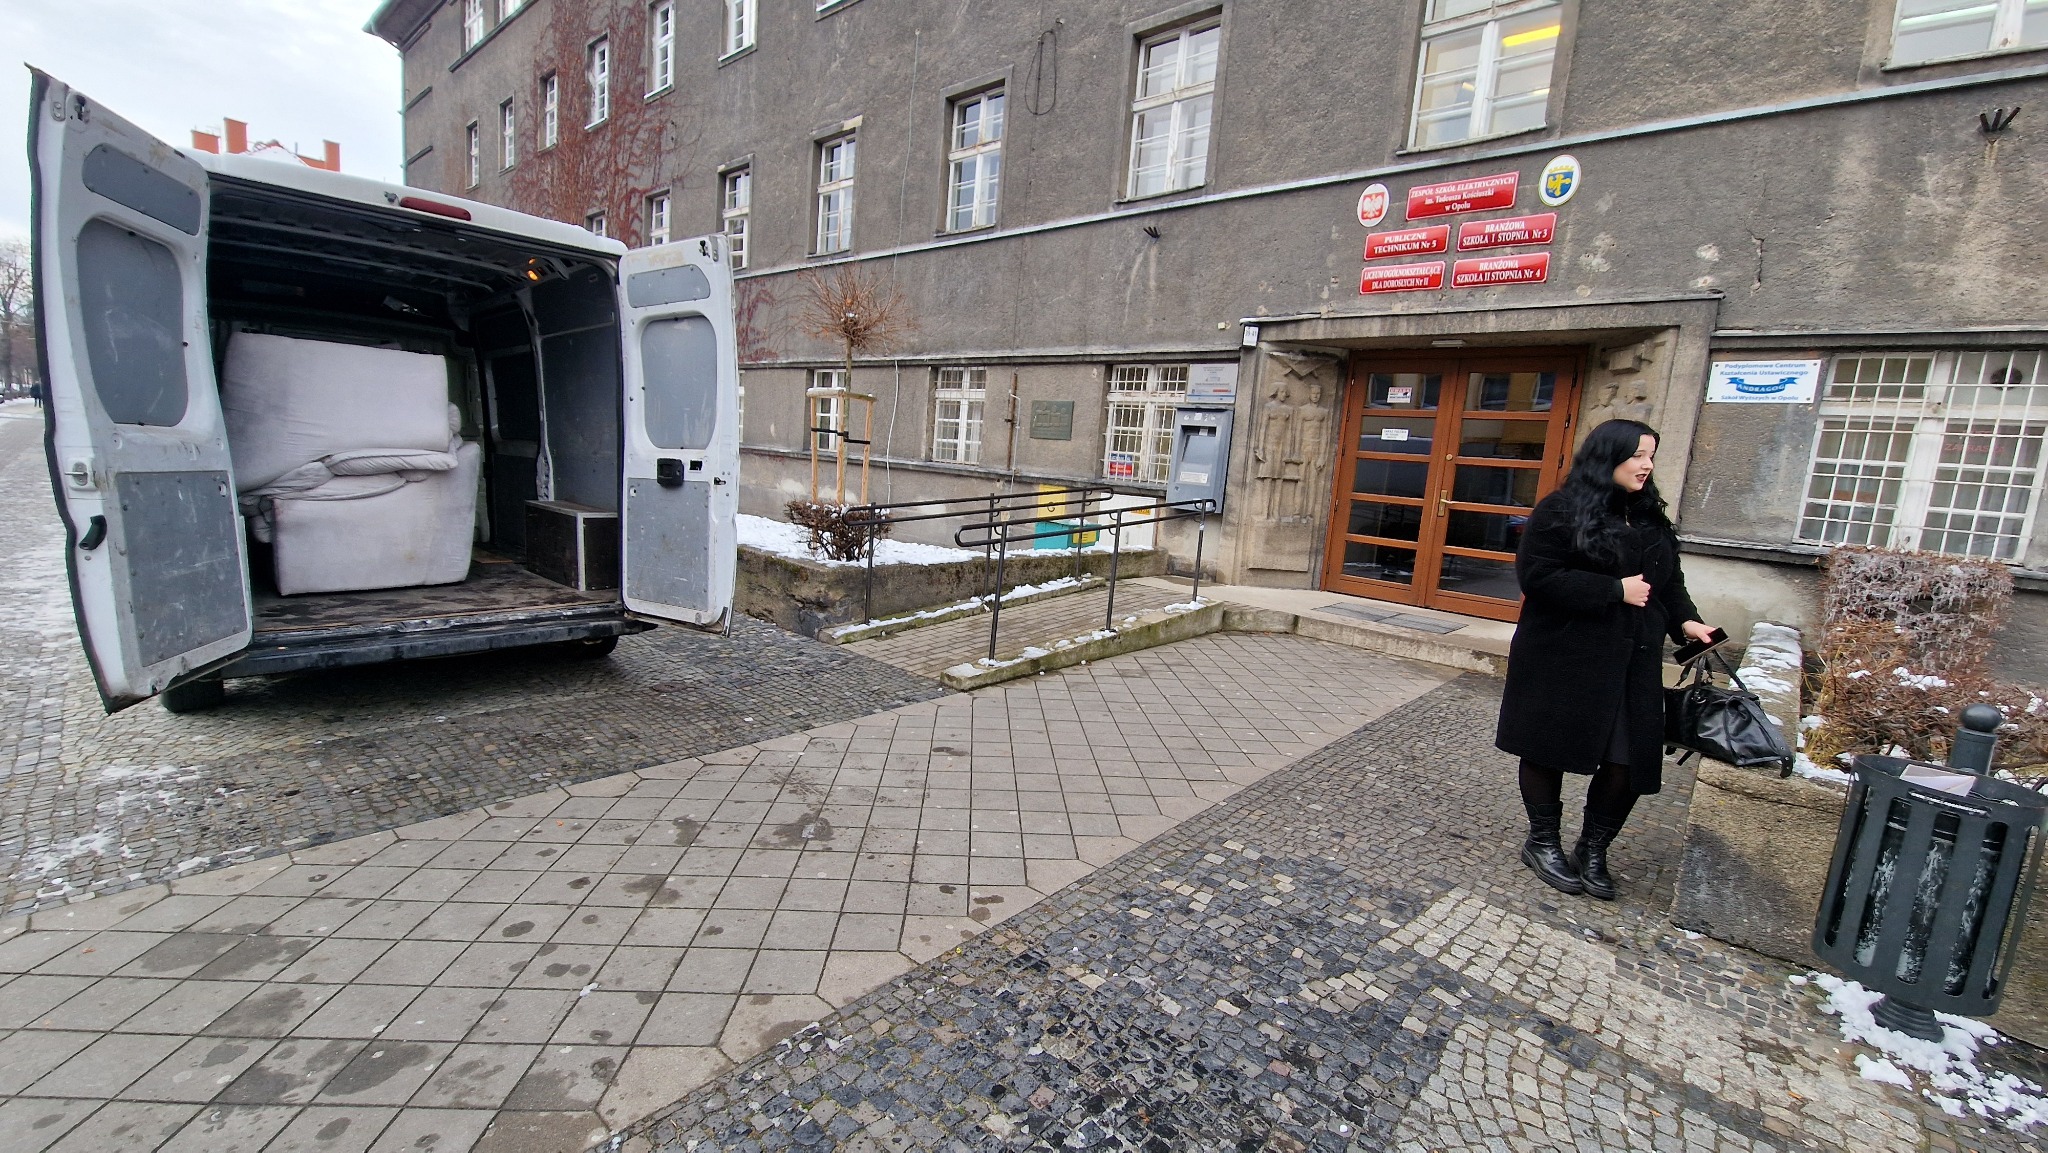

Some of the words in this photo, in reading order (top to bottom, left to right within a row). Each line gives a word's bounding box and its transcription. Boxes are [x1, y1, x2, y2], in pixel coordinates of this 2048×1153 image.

[1411, 188, 1434, 198] ZESPÓŁ
[1435, 185, 1457, 193] SZKÓŁ
[1457, 177, 1515, 190] ELEKTRYCZNYCH
[1424, 197, 1434, 205] im.
[1435, 194, 1461, 203] Tadeusza
[1462, 188, 1494, 199] Kościuszki
[1451, 201, 1471, 211] Opolu
[1485, 220, 1525, 233] BRANŻOWA
[1384, 232, 1427, 244] PUBLICZNE
[1462, 234, 1489, 246] SZKOŁA
[1491, 233, 1495, 243] I
[1497, 230, 1529, 242] STOPNIA
[1532, 229, 1542, 239] Nr
[1542, 229, 1548, 238] 3
[1373, 242, 1420, 254] TECHNIKUM
[1421, 241, 1431, 249] Nr
[1431, 239, 1437, 248] 5
[1478, 259, 1519, 271] BRANŻOWA
[1364, 269, 1384, 279] LICEUM
[1384, 265, 1441, 277] OGÓLNOKSZTAŁCĄCE
[1456, 272, 1483, 283] SZKOŁA
[1484, 271, 1490, 281] II
[1491, 269, 1522, 281] STOPNIA
[1523, 269, 1534, 279] Nr
[1535, 268, 1541, 278] 4
[1371, 281, 1383, 290] DLA
[1383, 278, 1415, 289] DOROSŁYCH
[1415, 278, 1423, 286] Nr
[1737, 383, 1785, 392] ANDRAGOG
